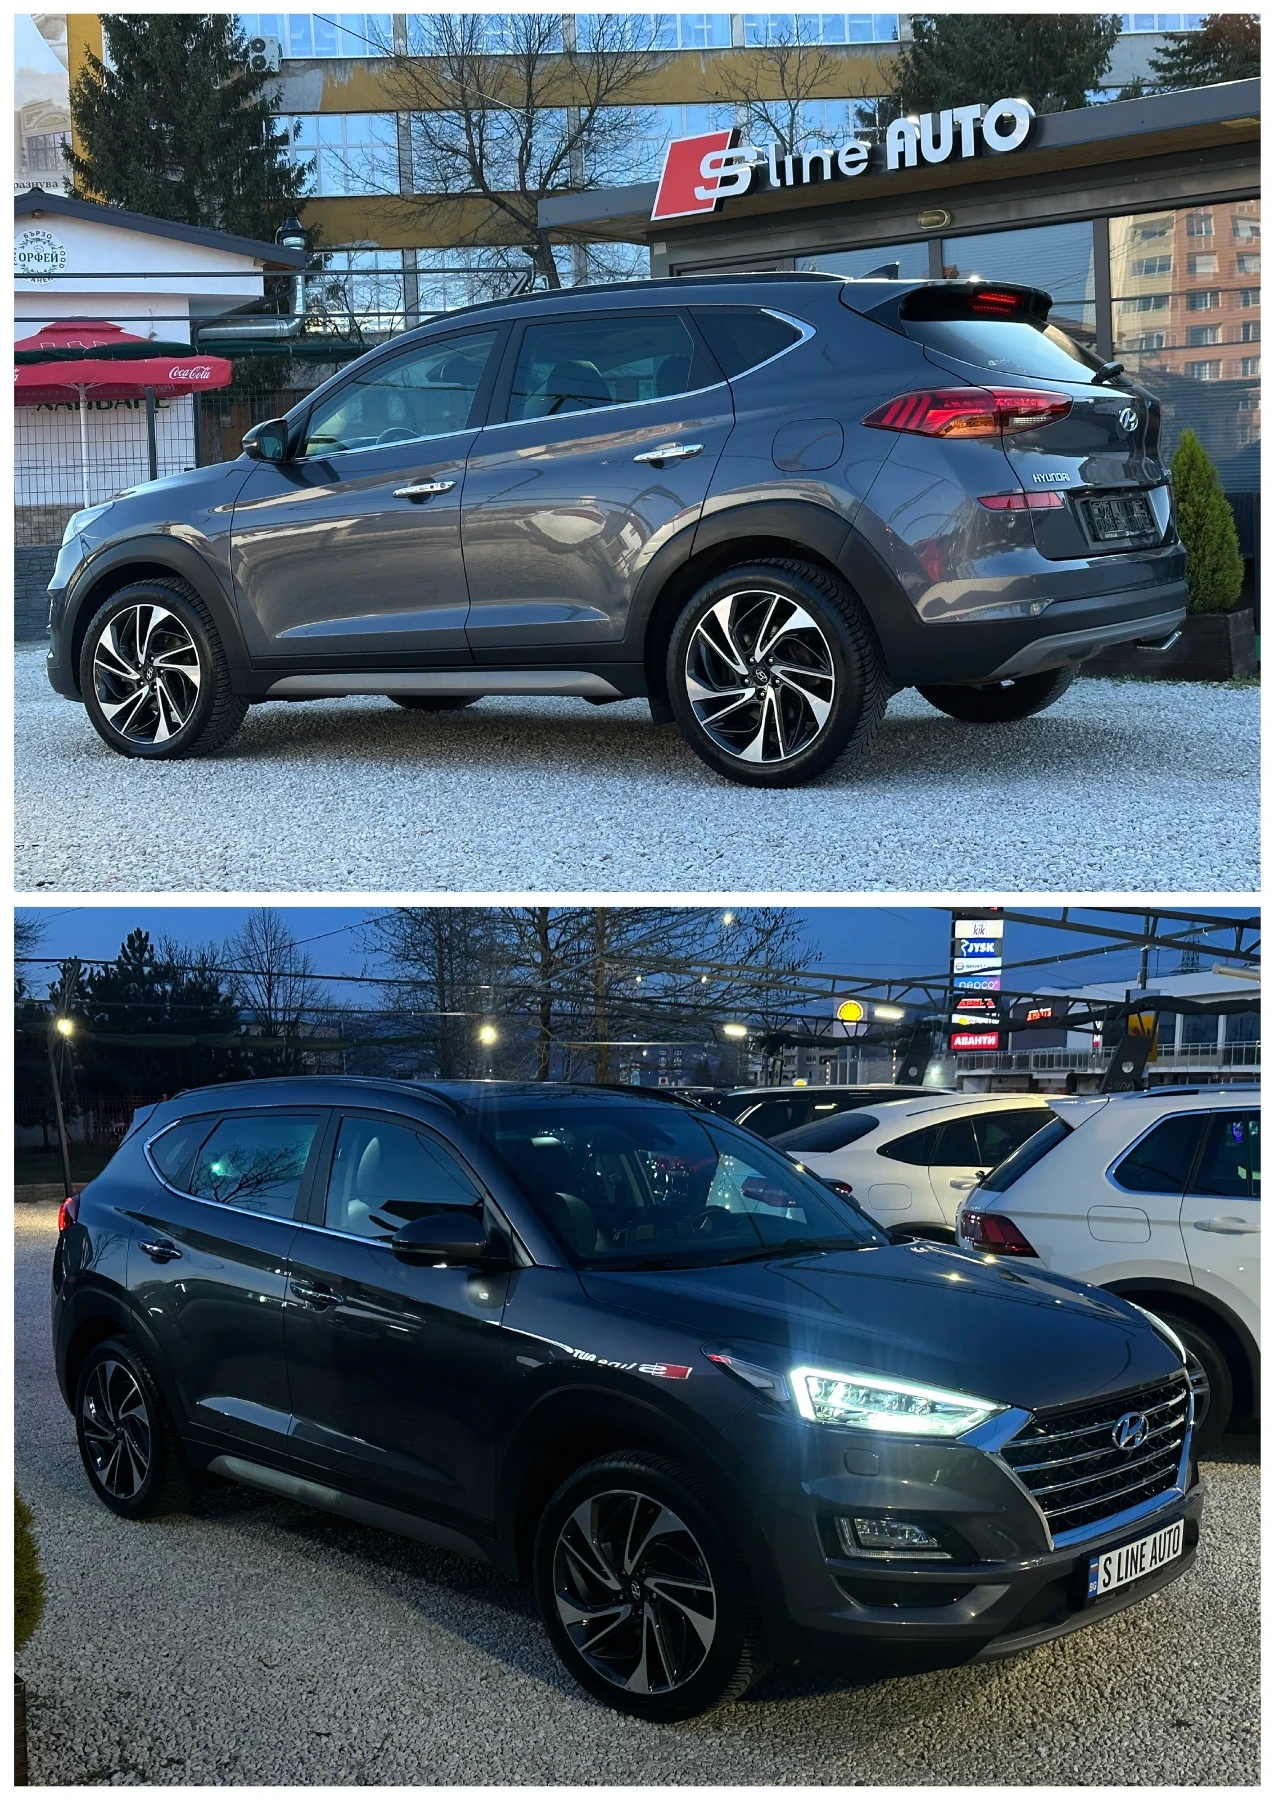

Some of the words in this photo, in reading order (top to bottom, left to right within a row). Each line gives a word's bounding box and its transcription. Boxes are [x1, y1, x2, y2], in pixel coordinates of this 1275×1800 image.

[694, 146, 758, 201] S
[769, 140, 870, 188] line
[886, 97, 1035, 170] AUTO
[23, 230, 53, 240] БЪРЗО
[18, 250, 59, 263] ОРФЕЙ
[58, 245, 67, 269] FOOD
[1032, 472, 1071, 483] HYUNDAI
[973, 924, 986, 936] kik
[967, 942, 995, 953] JYSK
[953, 1035, 997, 1046] АВАНТИ
[1102, 1556, 1112, 1588] S
[1116, 1541, 1147, 1582] LINE
[1149, 1525, 1180, 1567] AUTO
[1088, 1581, 1098, 1593] BG
